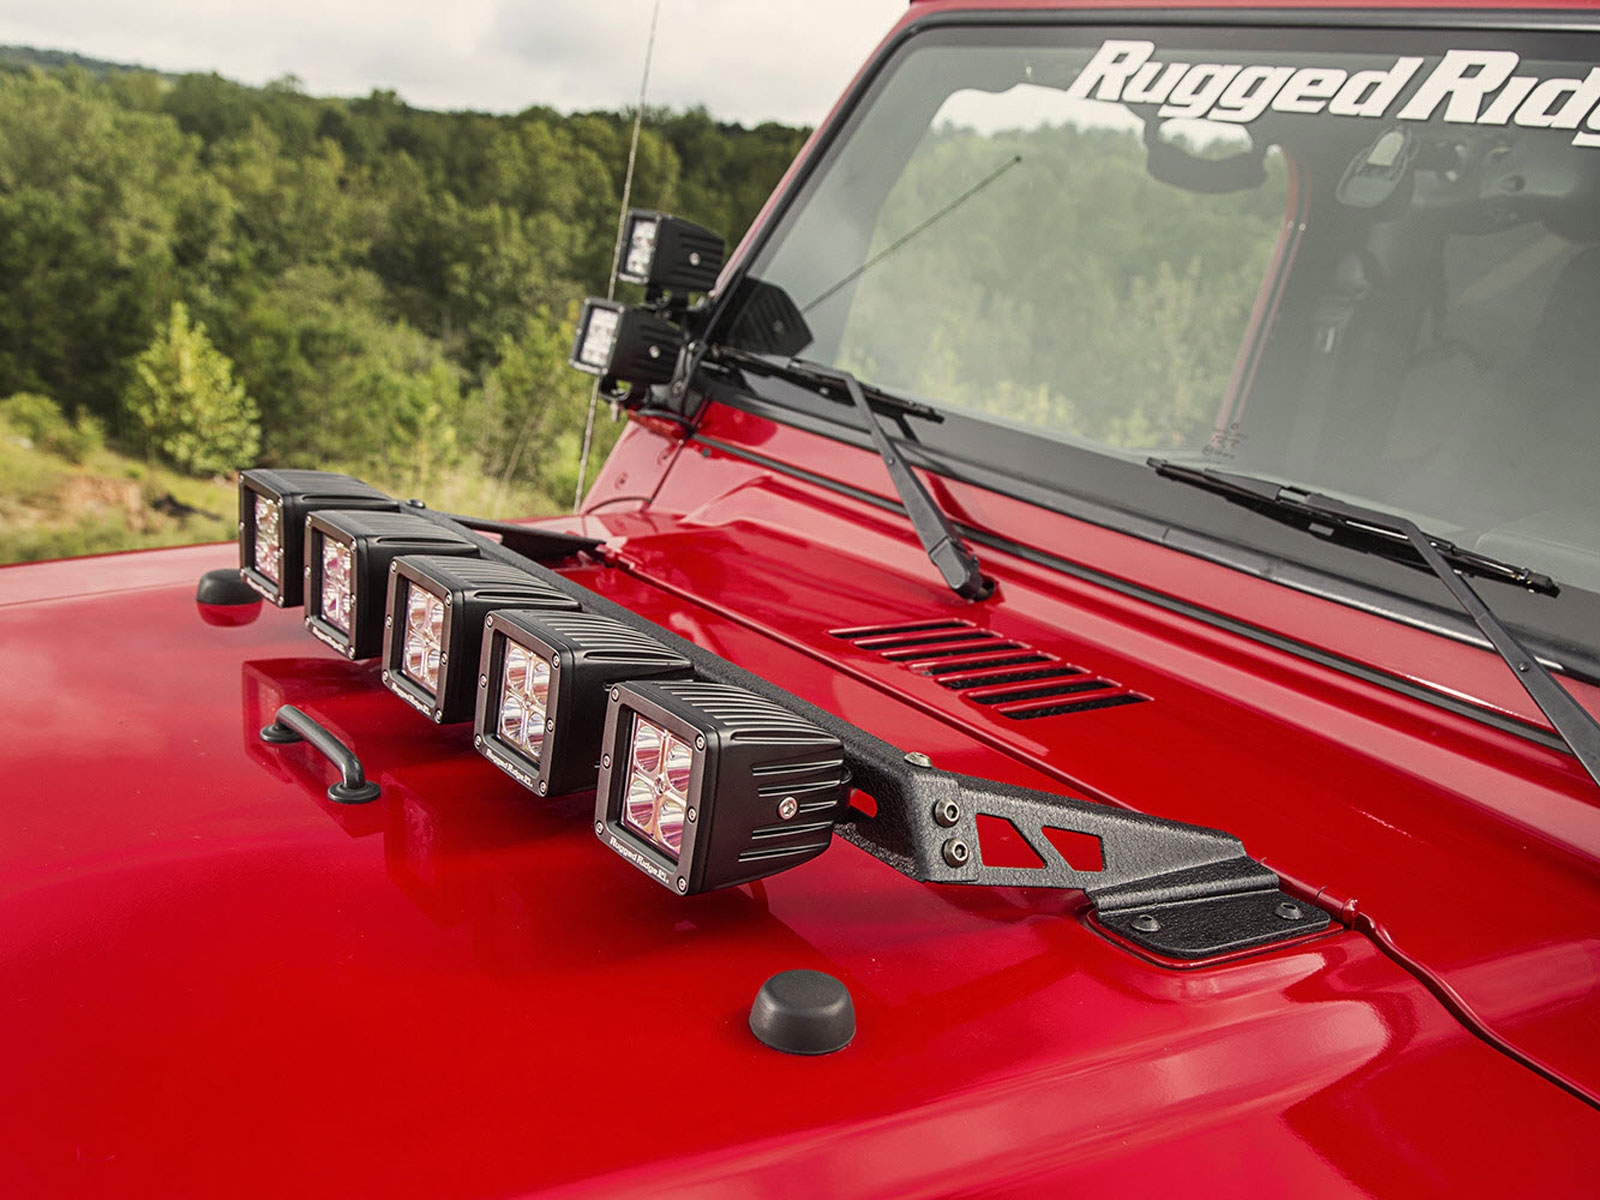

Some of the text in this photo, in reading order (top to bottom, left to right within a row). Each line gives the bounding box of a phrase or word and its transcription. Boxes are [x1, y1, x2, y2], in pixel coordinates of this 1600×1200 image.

[1067, 40, 1424, 122] Rugged
[610, 836, 658, 875] Rugged Ridge
